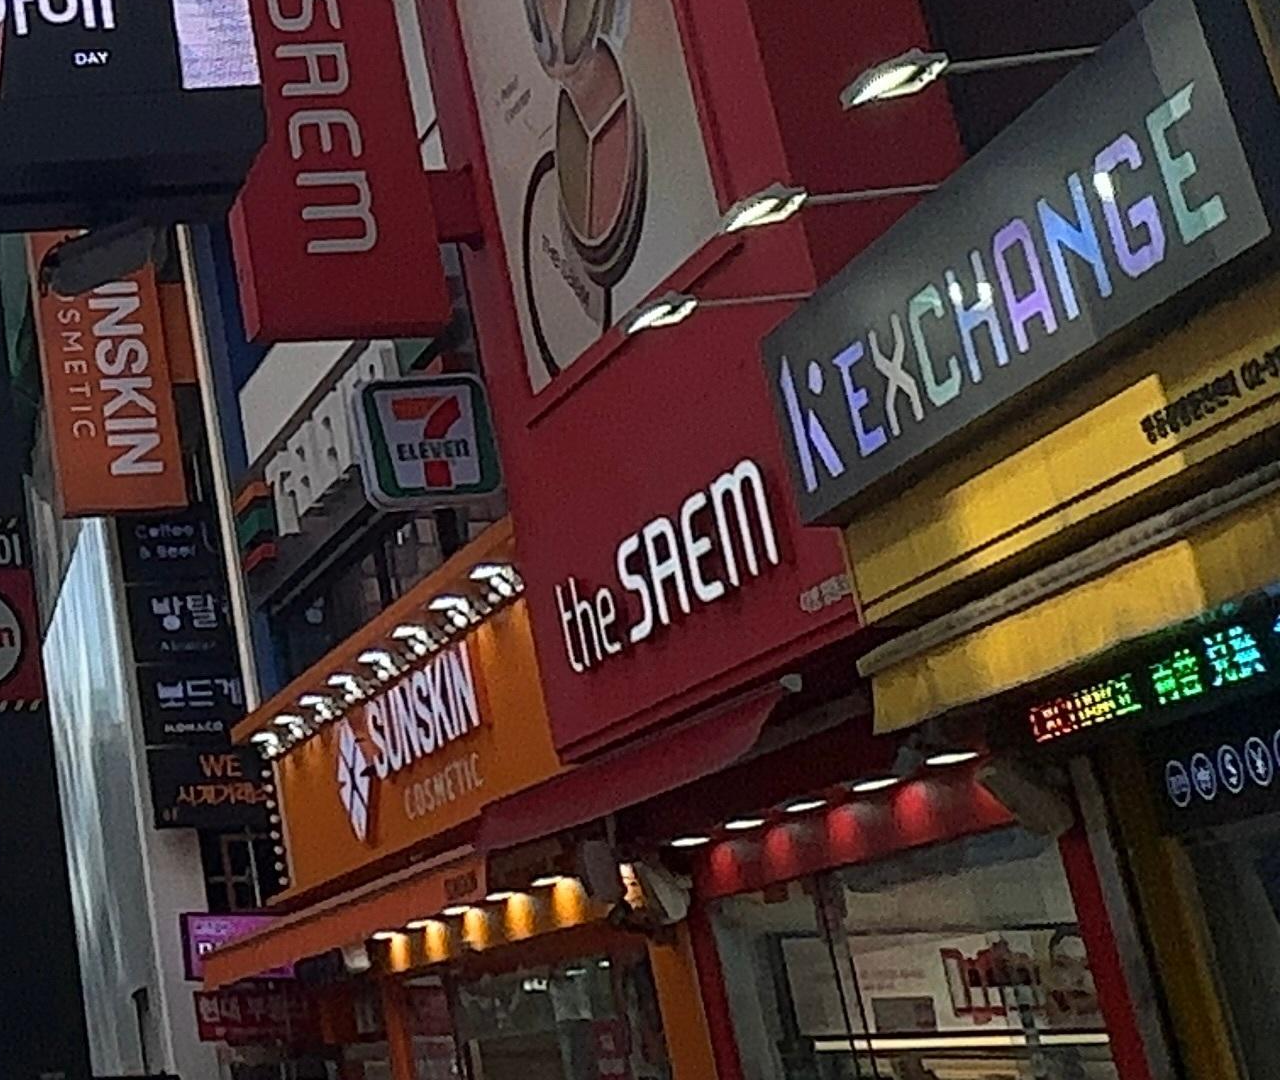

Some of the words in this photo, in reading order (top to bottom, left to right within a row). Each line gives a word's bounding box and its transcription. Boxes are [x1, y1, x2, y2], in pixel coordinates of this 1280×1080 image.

[74, 51, 109, 66] DAY
[151, 593, 229, 631] 방탈
[555, 576, 623, 673] the
[365, 639, 481, 781] SUNSKIN
[403, 751, 485, 821] COSMETIC
